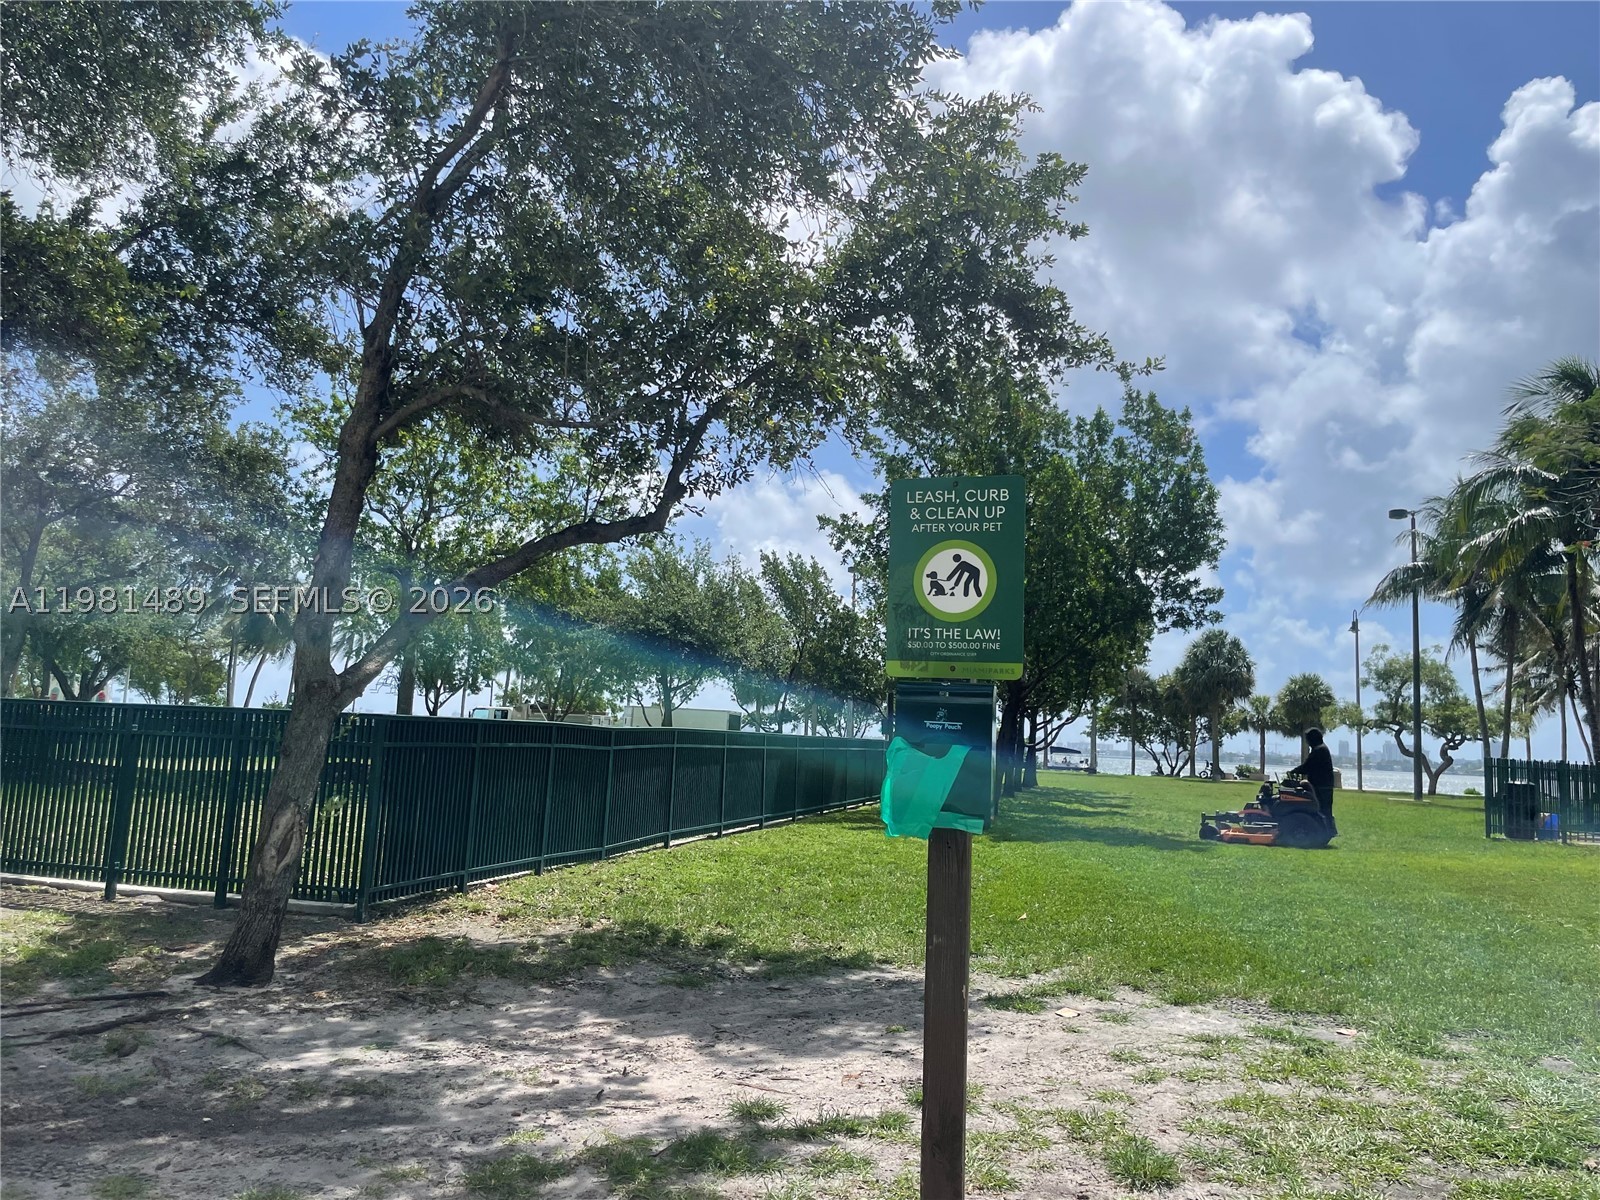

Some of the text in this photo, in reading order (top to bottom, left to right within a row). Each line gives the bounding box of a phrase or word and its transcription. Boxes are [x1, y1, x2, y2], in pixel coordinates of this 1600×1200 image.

[906, 488, 1010, 504] LEASH, CURB
[909, 505, 1006, 520] & CLEAN UP
[911, 521, 1003, 533] AFTER YOUR PET
[908, 627, 1001, 640] IT'S THE LAW!
[907, 641, 1001, 650] $50.00 TO $500.00 FINE
